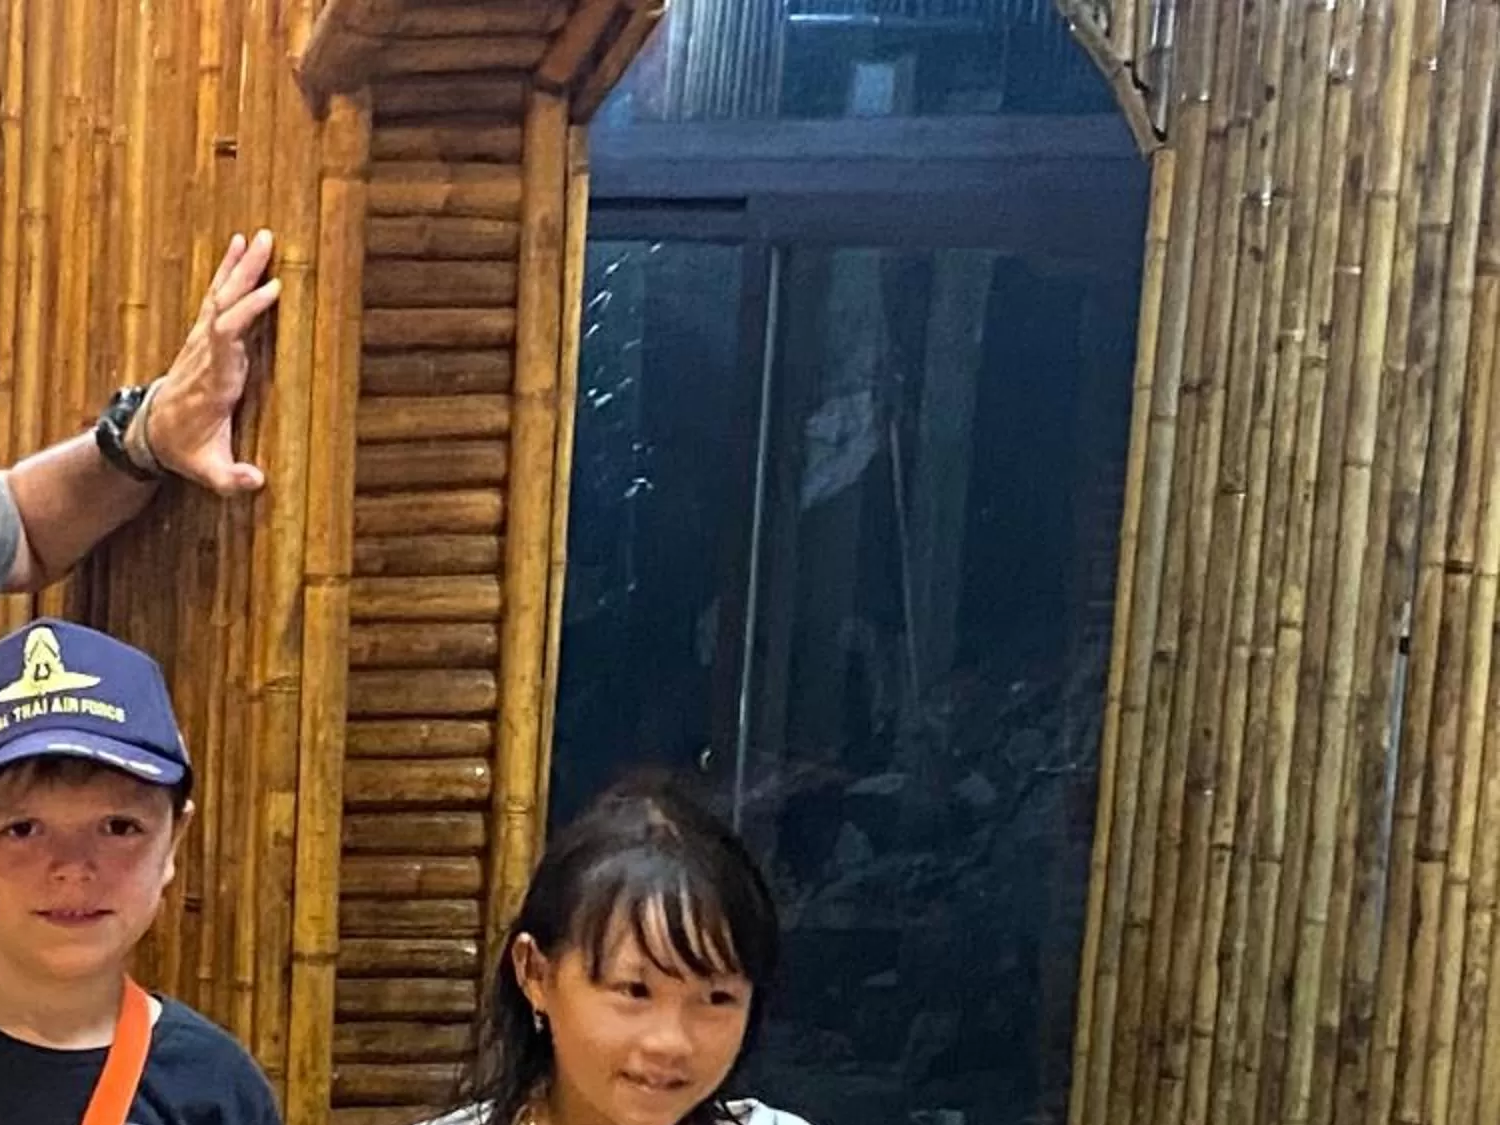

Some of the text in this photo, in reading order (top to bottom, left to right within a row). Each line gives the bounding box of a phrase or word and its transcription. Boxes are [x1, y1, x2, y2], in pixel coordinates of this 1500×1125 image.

[12, 698, 48, 723] THAI
[51, 696, 79, 713] AIR
[81, 698, 126, 723] FORCE
